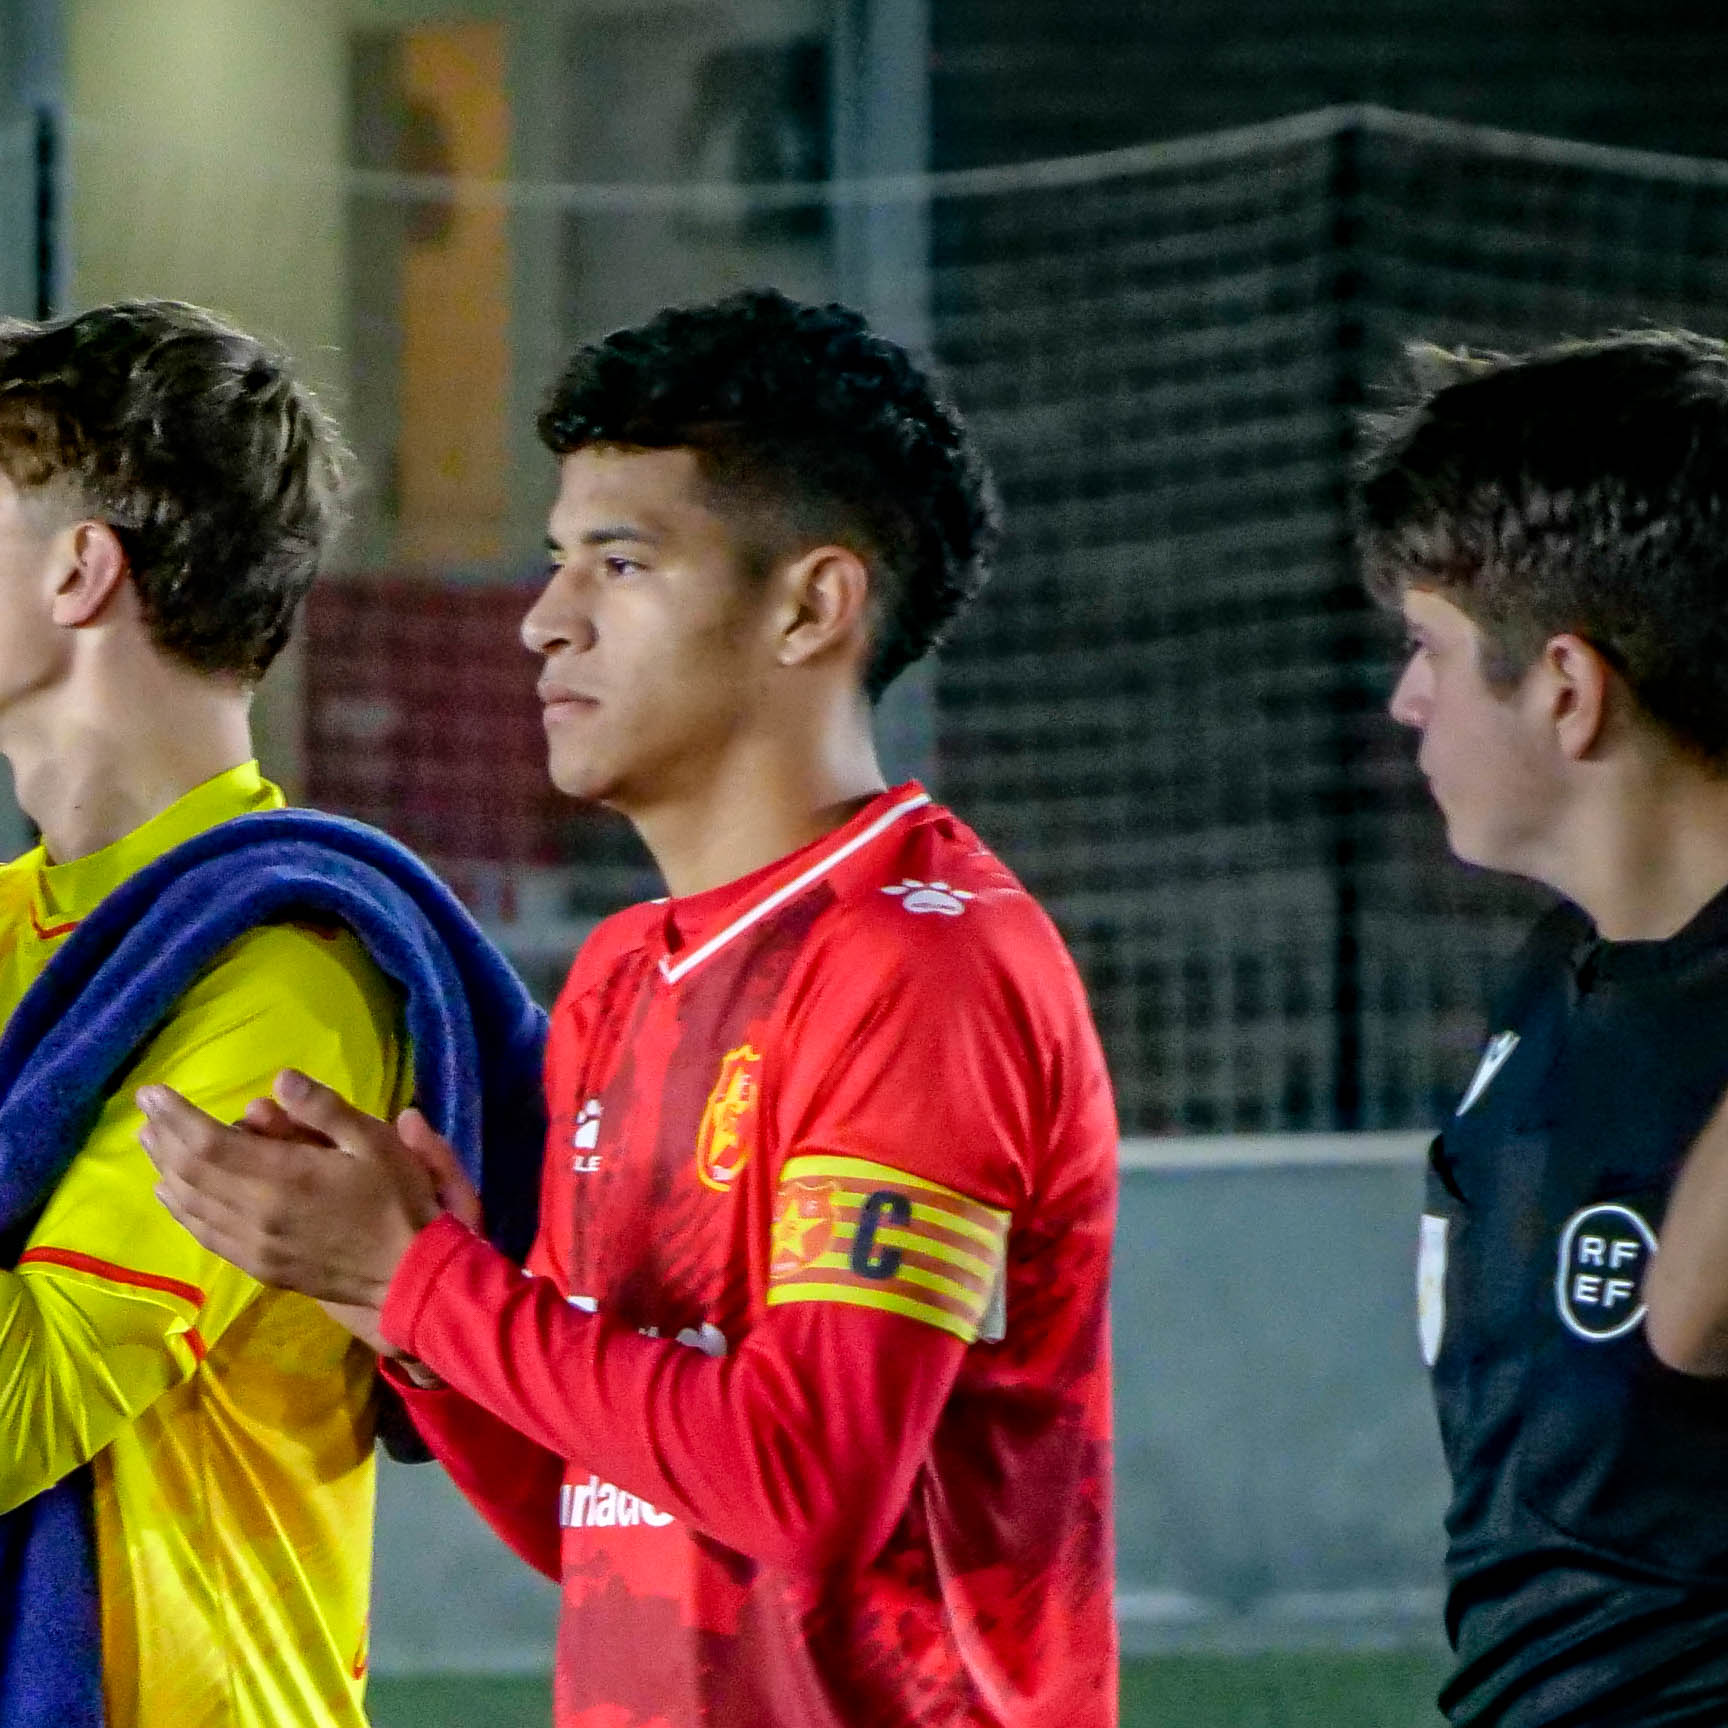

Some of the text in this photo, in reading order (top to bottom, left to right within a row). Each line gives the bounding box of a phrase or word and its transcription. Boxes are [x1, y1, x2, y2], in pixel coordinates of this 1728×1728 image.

[850, 1190, 913, 1280] C
[1577, 1234, 1641, 1269] RF
[1573, 1272, 1636, 1309] EF
